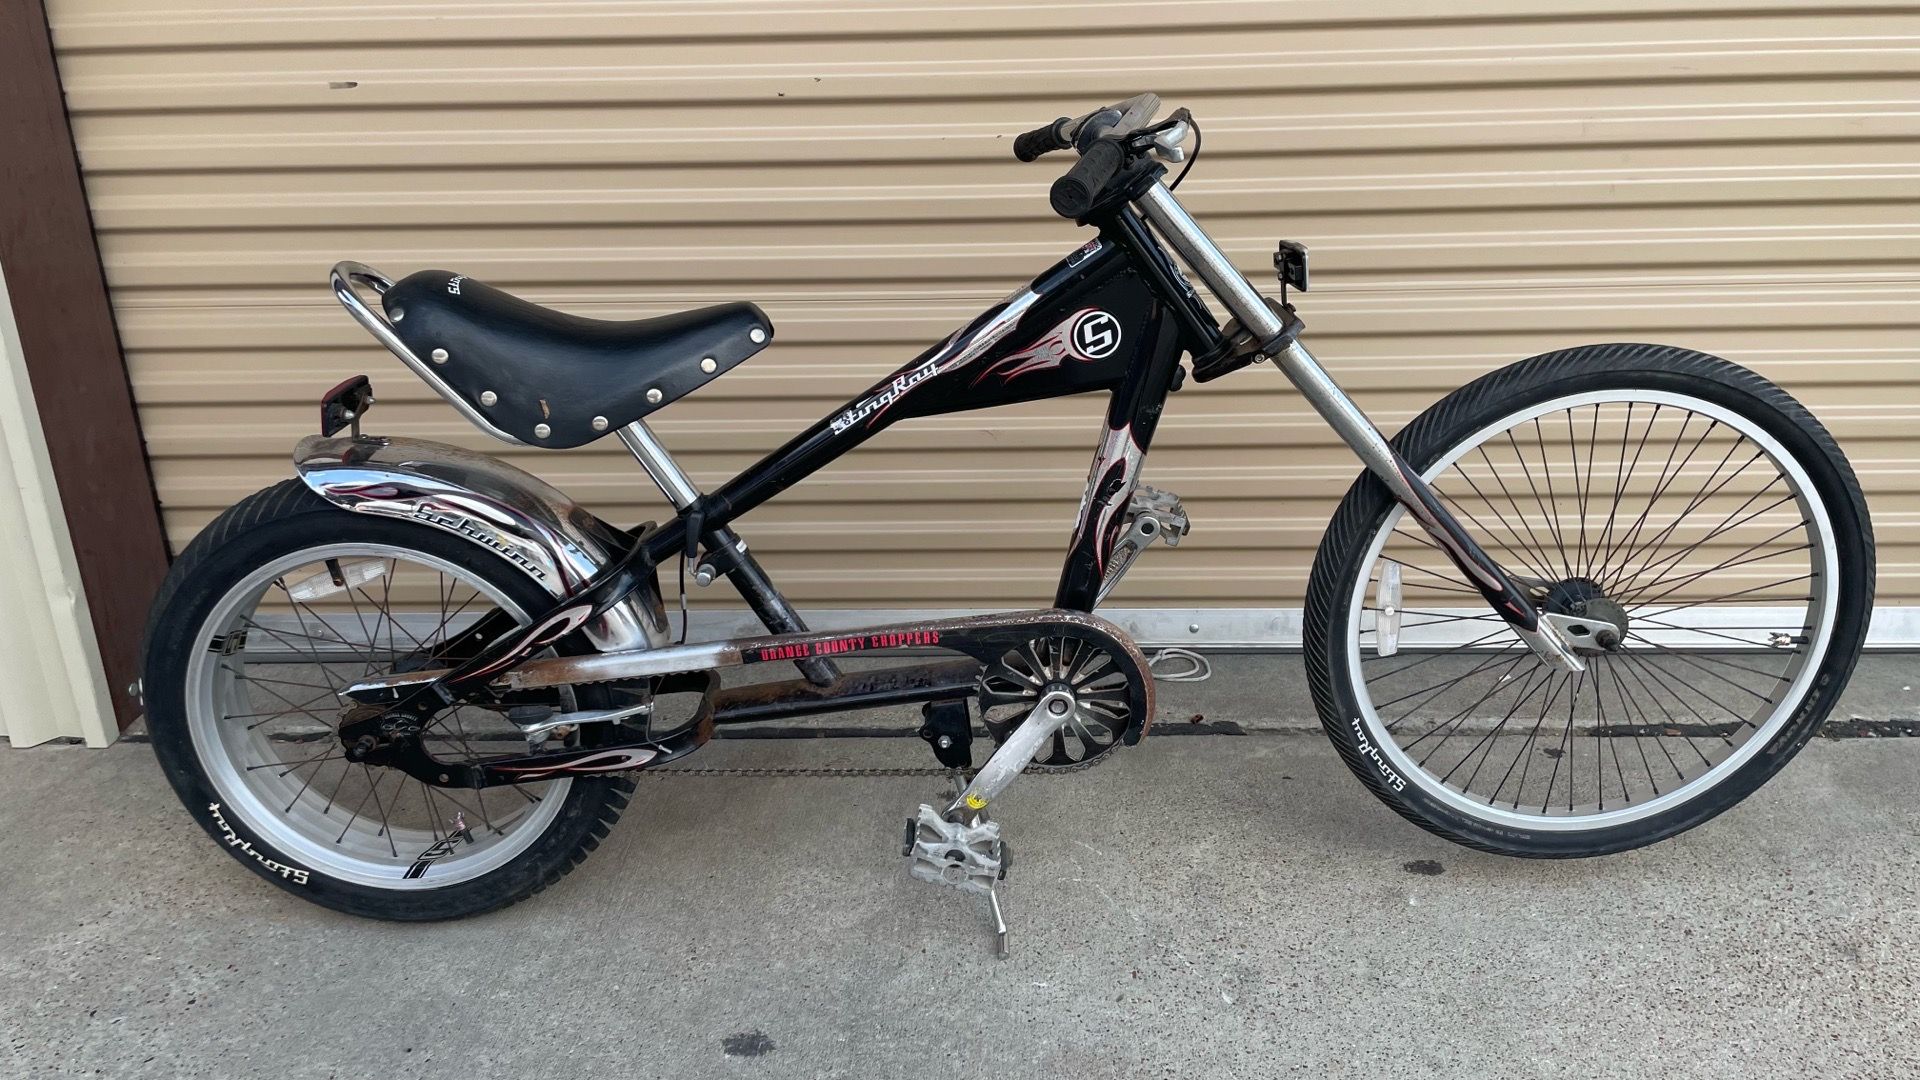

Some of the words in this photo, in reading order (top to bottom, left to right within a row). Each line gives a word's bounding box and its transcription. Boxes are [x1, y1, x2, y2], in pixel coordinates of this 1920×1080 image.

[414, 501, 547, 581] Schwinn
[761, 642, 811, 661] ORANGE
[815, 636, 867, 655] COUNTY
[871, 630, 940, 648] CHOPPERS
[1351, 717, 1407, 792] StingRay
[208, 802, 310, 885] StingRay
